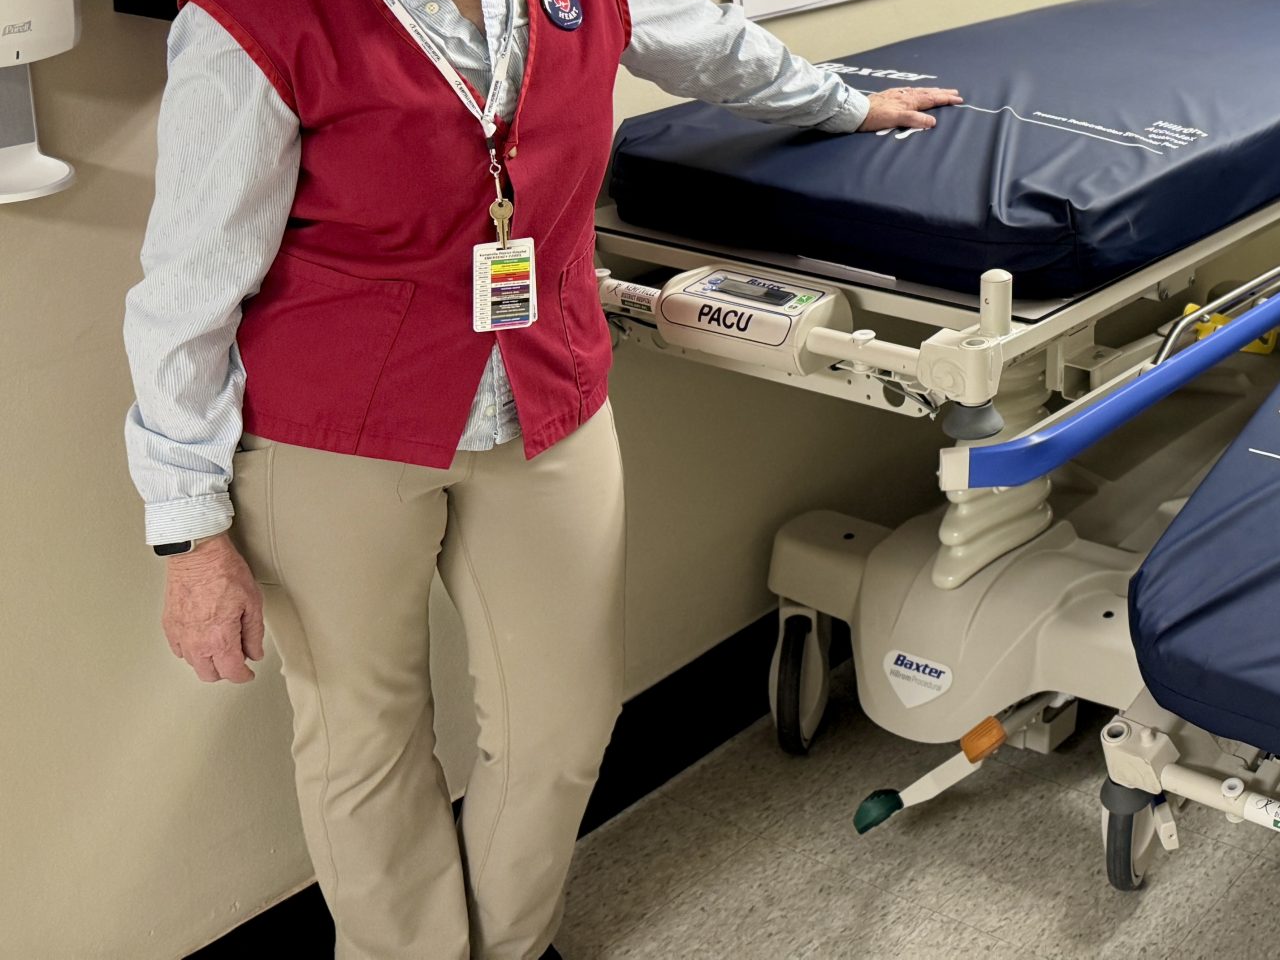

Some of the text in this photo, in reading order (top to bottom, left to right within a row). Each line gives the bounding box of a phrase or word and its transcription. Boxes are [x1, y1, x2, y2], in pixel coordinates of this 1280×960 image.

[559, 6, 579, 20] HEART
[698, 304, 753, 332] PACU
[893, 653, 946, 679] Baxter
